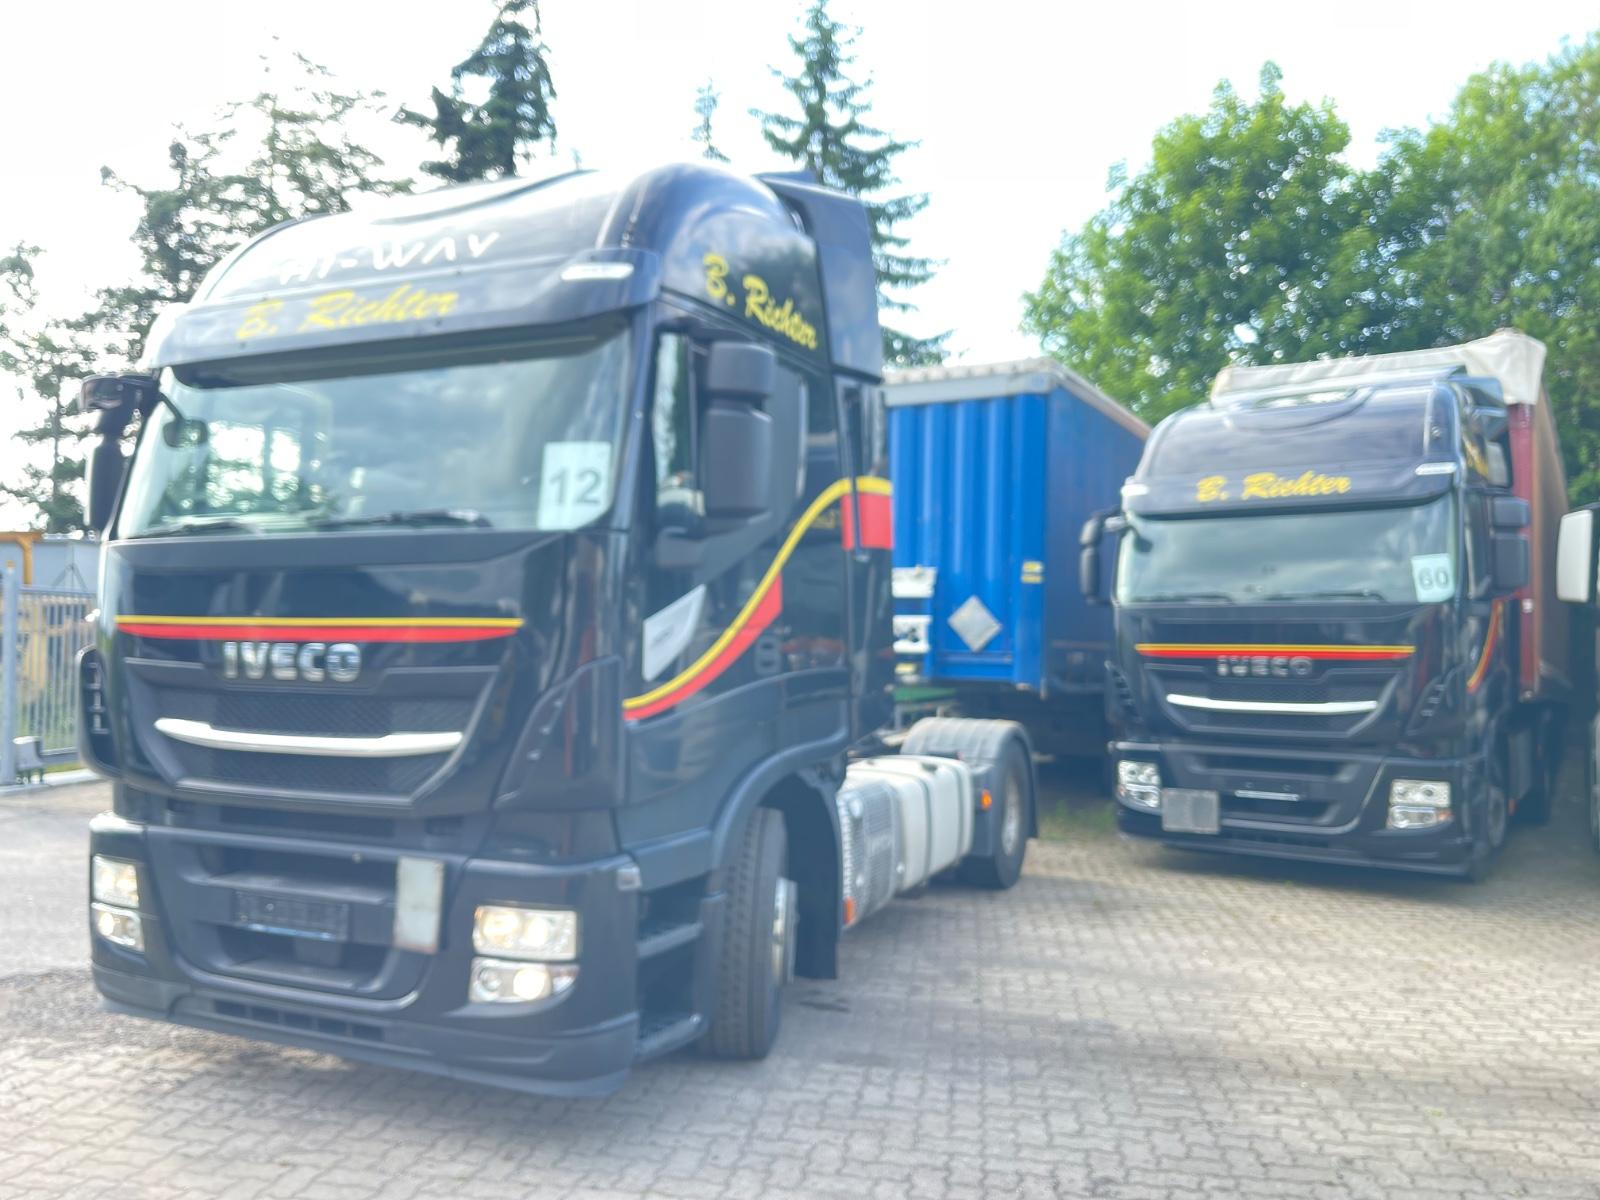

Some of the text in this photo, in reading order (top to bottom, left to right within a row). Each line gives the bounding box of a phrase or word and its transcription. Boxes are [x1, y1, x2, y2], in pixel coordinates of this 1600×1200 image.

[236, 284, 459, 340] B. Richter
[703, 252, 817, 350] B. Richter
[548, 467, 602, 506] 12
[1196, 470, 1352, 502] B. Richter
[1418, 566, 1450, 591] 60
[224, 641, 362, 682] IVECO
[1216, 655, 1313, 678] IVECO
